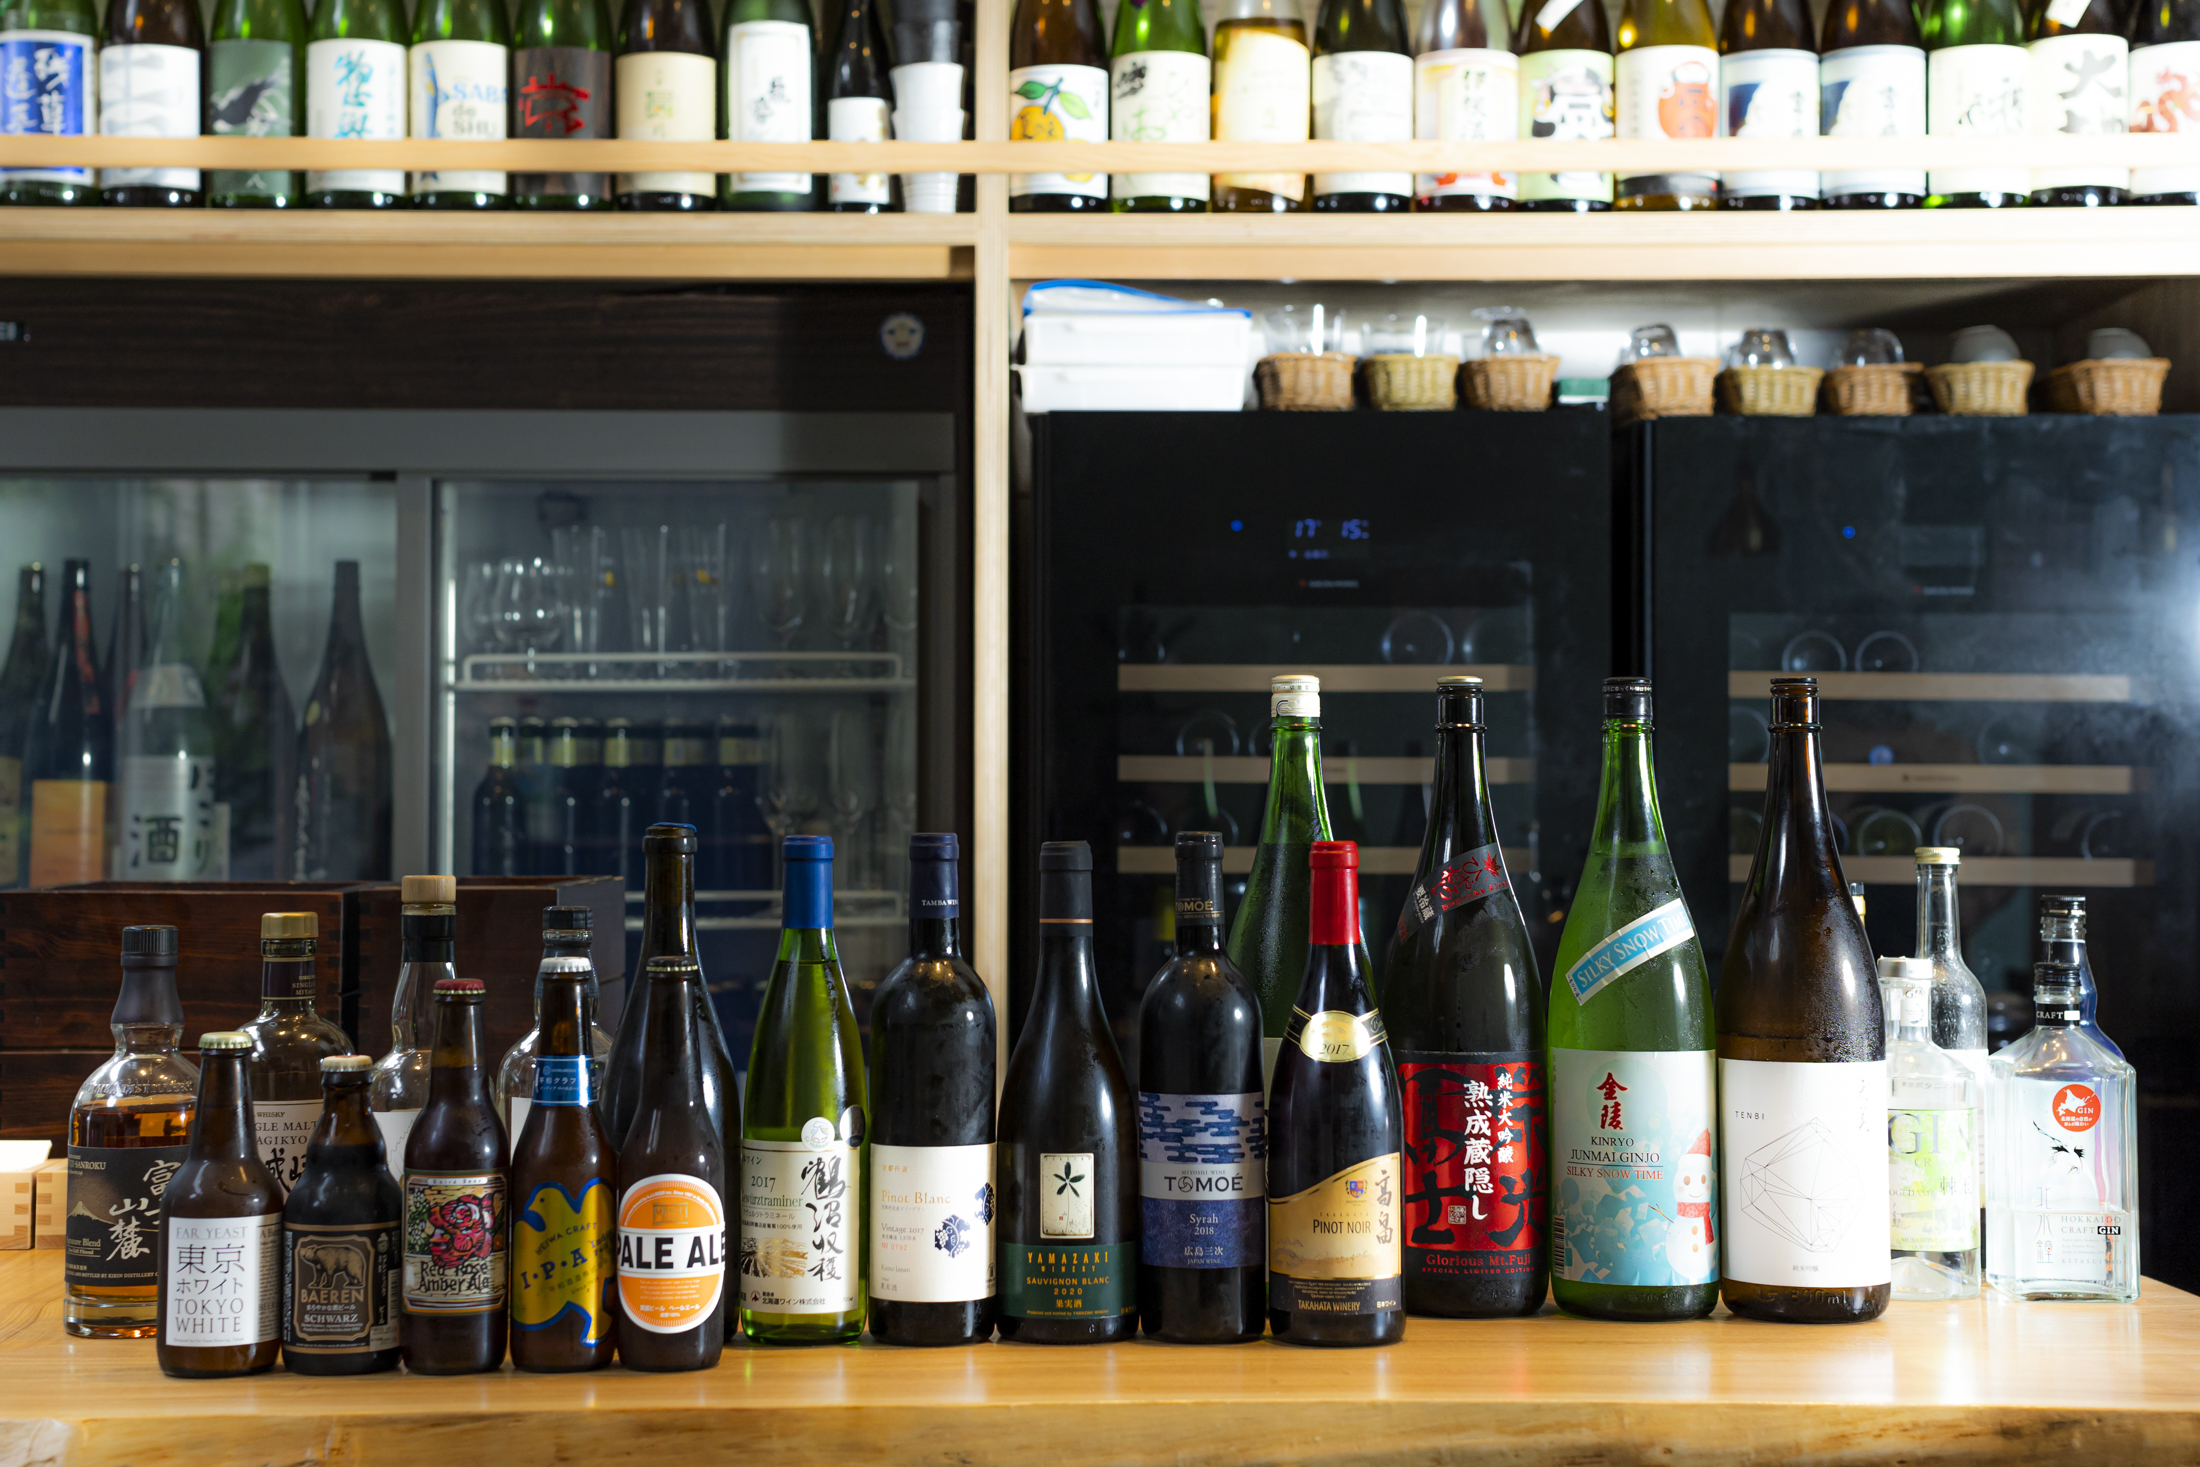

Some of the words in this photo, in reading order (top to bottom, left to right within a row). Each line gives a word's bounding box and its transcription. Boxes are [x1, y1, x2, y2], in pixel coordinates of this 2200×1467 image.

[452, 82, 507, 103] SAB
[129, 815, 182, 868] 酒
[1577, 951, 1614, 988] SILKY
[1613, 925, 1660, 960] SNOW
[1657, 911, 1688, 935] TIME
[2037, 1011, 2063, 1019] CRAFT
[1319, 1043, 1350, 1056] 2017
[1595, 1072, 1629, 1131] 金陵
[1497, 1073, 1514, 1164] 純米大吟醸
[1735, 1110, 1765, 1120] TENBI
[255, 1122, 279, 1132] GLE
[282, 1120, 319, 1131] MALT
[257, 1135, 308, 1145] AGIKYO
[1888, 1113, 1972, 1154] GIN
[1590, 1136, 1635, 1147] KINRYO
[1463, 1080, 1495, 1221] 熟成蔵隠し
[1570, 1149, 1616, 1163] JUNMAI
[1619, 1152, 1660, 1164] GINJO
[1566, 1165, 1594, 1178] SILKY
[1596, 1168, 1632, 1180] SNOW
[1633, 1169, 1664, 1180] TIME
[750, 1174, 777, 1193] 2017
[1163, 1173, 1244, 1193] TOMOÉ
[742, 1193, 803, 1207] ewürztraminer
[881, 1189, 909, 1204] Pinot
[914, 1191, 952, 1205] Blanc
[1189, 1213, 1219, 1227] Syrah
[1312, 1218, 1344, 1234] PINOT
[1346, 1220, 1372, 1235] NOIR
[2061, 1215, 2122, 1224] HOKKAIDO
[176, 1227, 200, 1239] FAR
[205, 1226, 248, 1239] YEAST
[881, 1222, 907, 1235] Vintage
[909, 1227, 925, 1236] 2017
[1194, 1226, 1215, 1235] 2018
[2061, 1226, 2096, 1234] CRAFT
[2098, 1226, 2119, 1234] GIN
[82, 1238, 102, 1247] Blend
[535, 1232, 564, 1256] HEIWA
[565, 1222, 597, 1236] CRAFT
[686, 1230, 725, 1269] ALE
[1184, 1245, 1224, 1256] 広島三次
[176, 1244, 246, 1274] 東京
[1027, 1251, 1109, 1264] YAMAZAKI
[1426, 1253, 1484, 1266] Glorious
[1488, 1253, 1531, 1266] Mt.Fuji
[420, 1260, 446, 1277] Red
[455, 1262, 489, 1277] Rose
[1041, 1265, 1096, 1273] WINERY
[176, 1278, 243, 1295] ホワイト
[419, 1277, 467, 1293] Amber
[467, 1274, 490, 1292] Ale
[1026, 1276, 1078, 1285] SAUVIGNON
[1081, 1276, 1110, 1285] BLANC
[301, 1288, 364, 1304] BAEREN
[1054, 1287, 1083, 1295] 2020
[174, 1298, 244, 1315] TOKYO
[762, 1297, 826, 1306] 北海道ワイン株式会社
[1056, 1299, 1083, 1308] 果実酒
[1298, 1299, 1332, 1312] TAKAHATA
[1332, 1301, 1361, 1312] WINERY
[175, 1316, 242, 1334] WHITE
[304, 1313, 359, 1324] SCHWARZ
